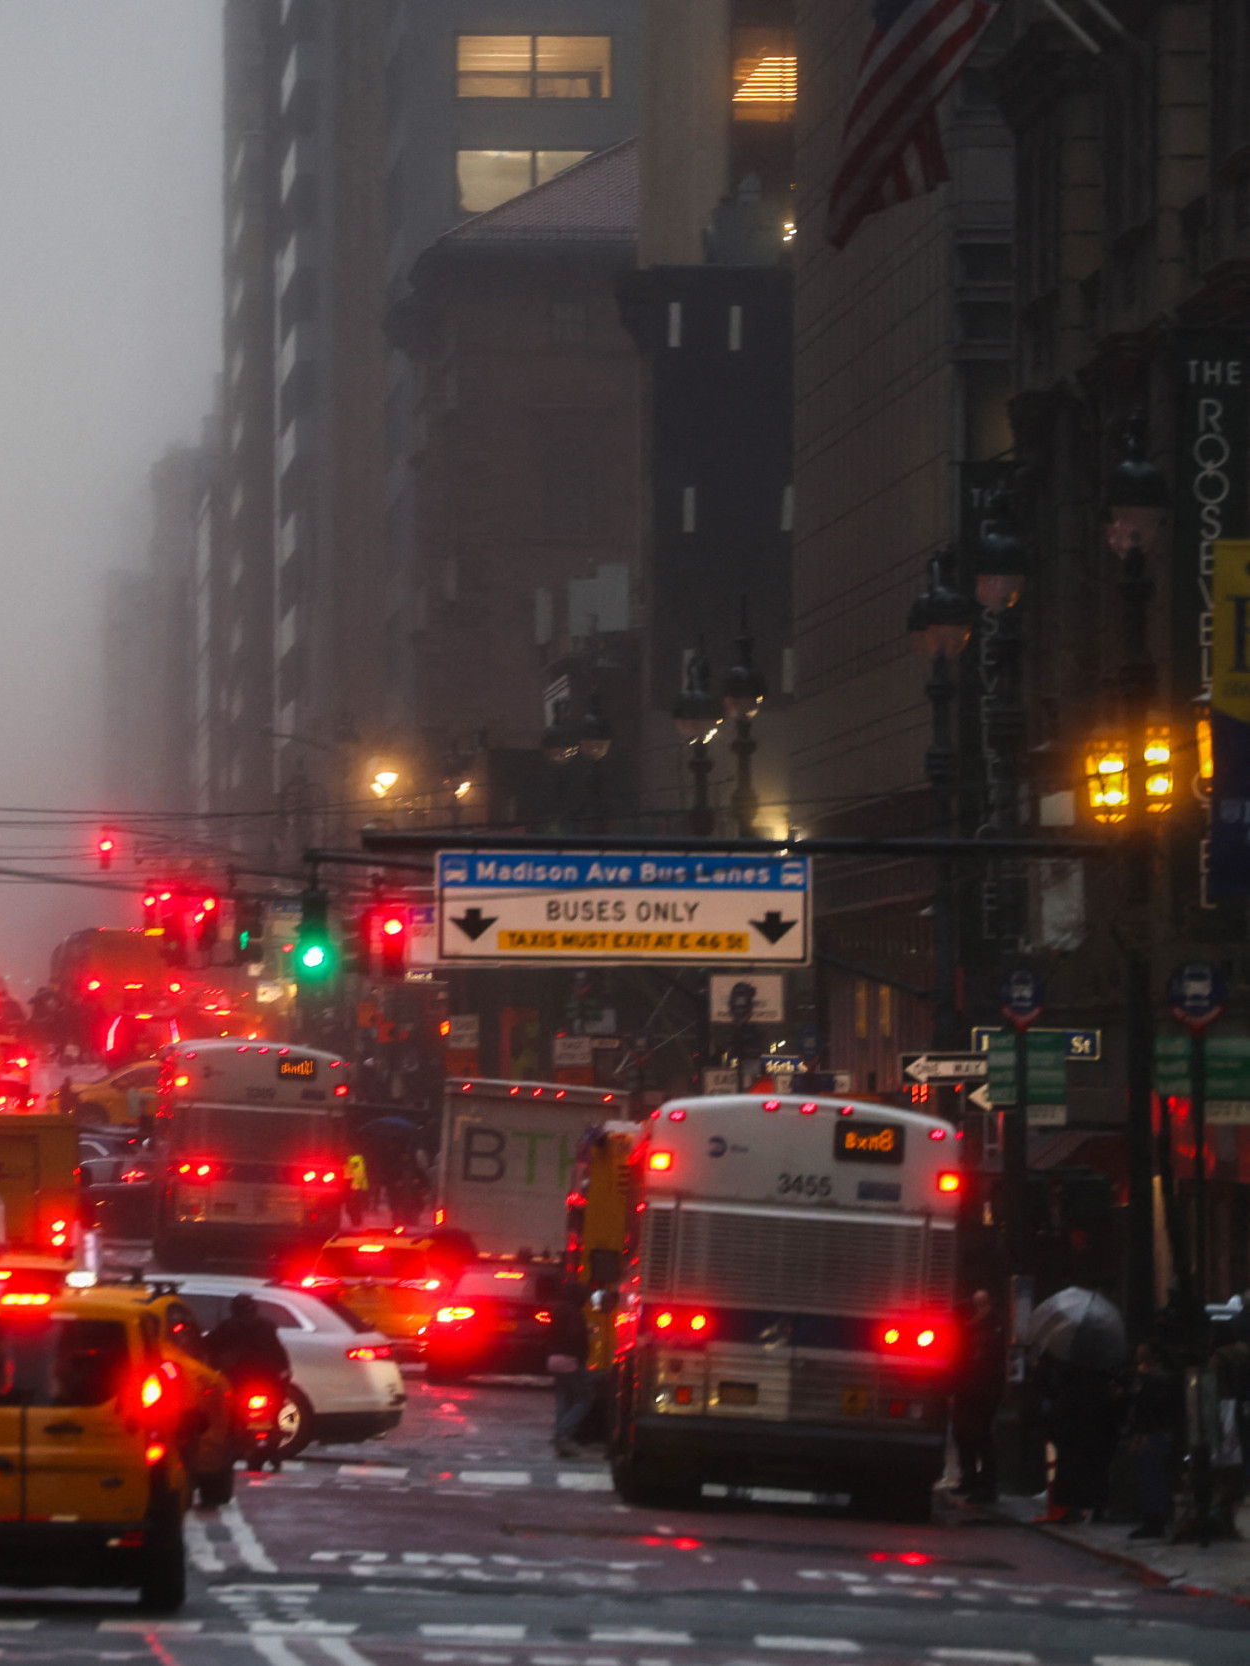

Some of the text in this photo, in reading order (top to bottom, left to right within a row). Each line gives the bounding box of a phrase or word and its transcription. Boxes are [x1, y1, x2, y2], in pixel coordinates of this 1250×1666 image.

[1188, 359, 1241, 386] THE
[1193, 398, 1230, 694] ROOSEVEL
[476, 861, 770, 885] Madison Ave Bus Lanes
[546, 900, 700, 923] BUSES ONLY
[507, 932, 744, 950] TAXIS MUST EXIT AT E 46 St
[1070, 1035, 1092, 1055] St
[778, 1172, 833, 1198] 3455
